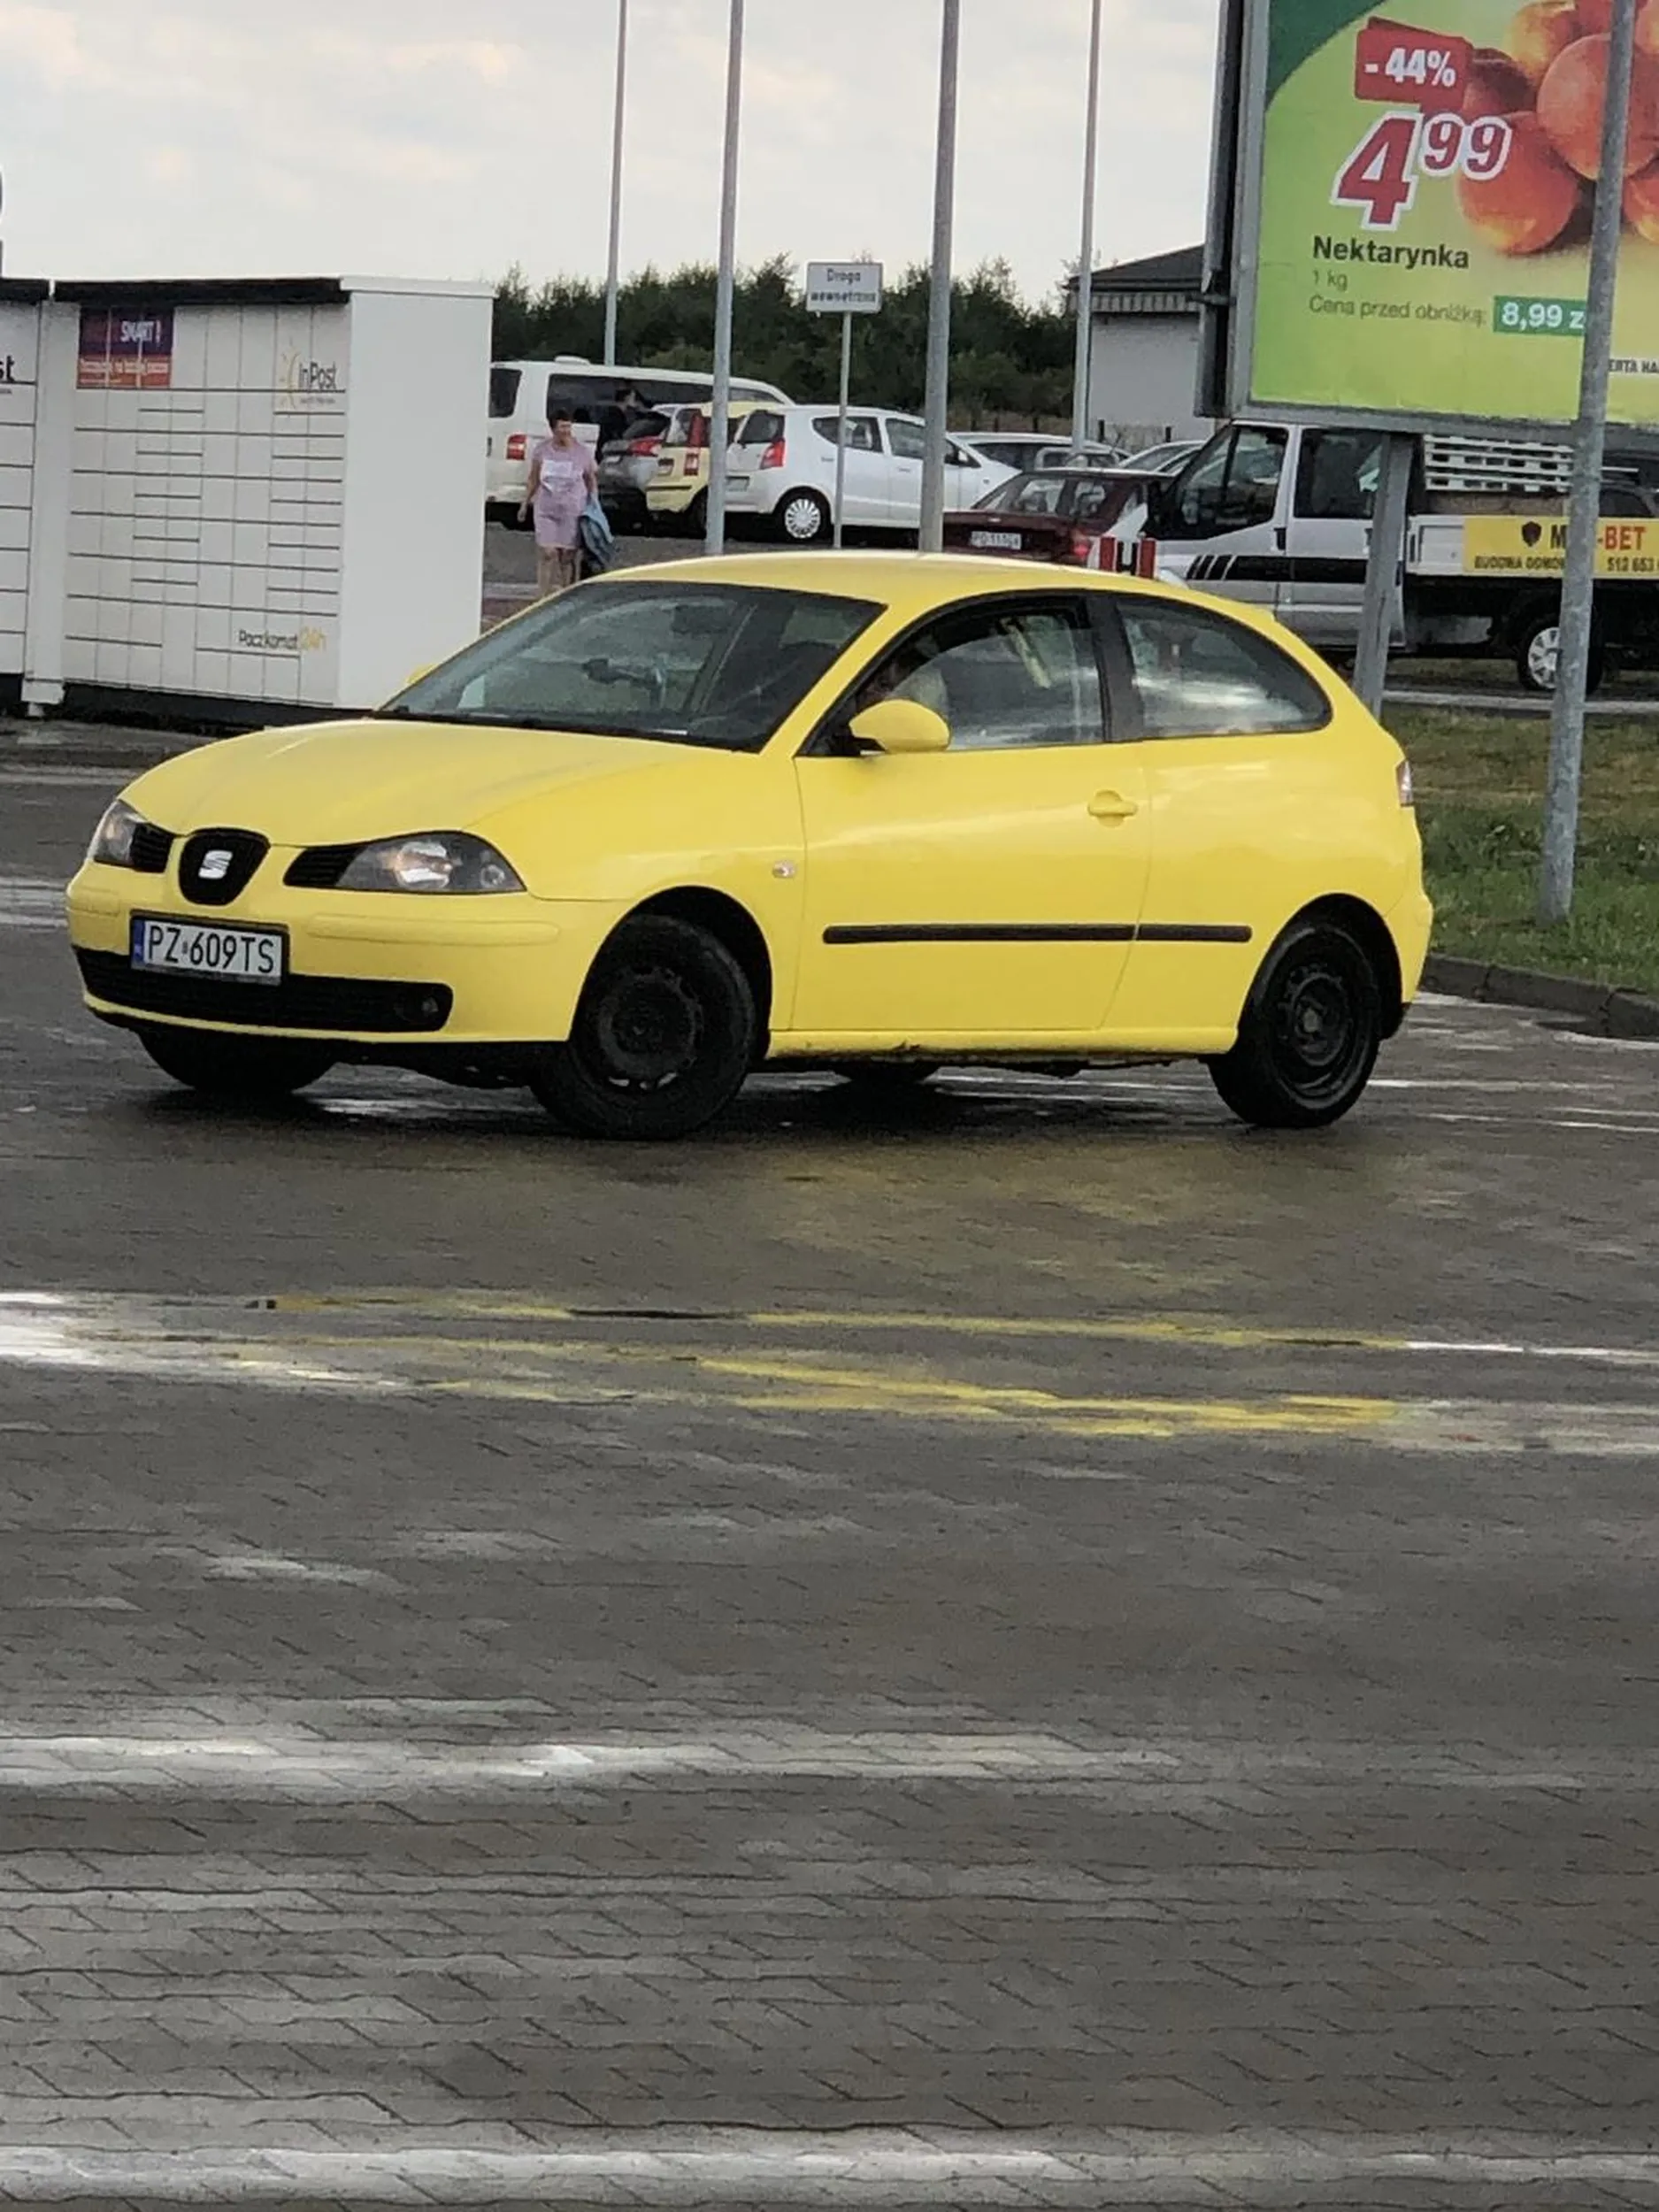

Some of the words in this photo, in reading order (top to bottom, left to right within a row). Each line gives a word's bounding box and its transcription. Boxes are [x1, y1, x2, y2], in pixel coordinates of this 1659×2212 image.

[1313, 235, 1470, 270] Nektarynka
[1327, 271, 1348, 291] kg
[1309, 295, 1355, 316] Cena
[1360, 301, 1410, 320] przed
[1502, 302, 1563, 331] 8,99
[189, 932, 274, 973] 609TS
